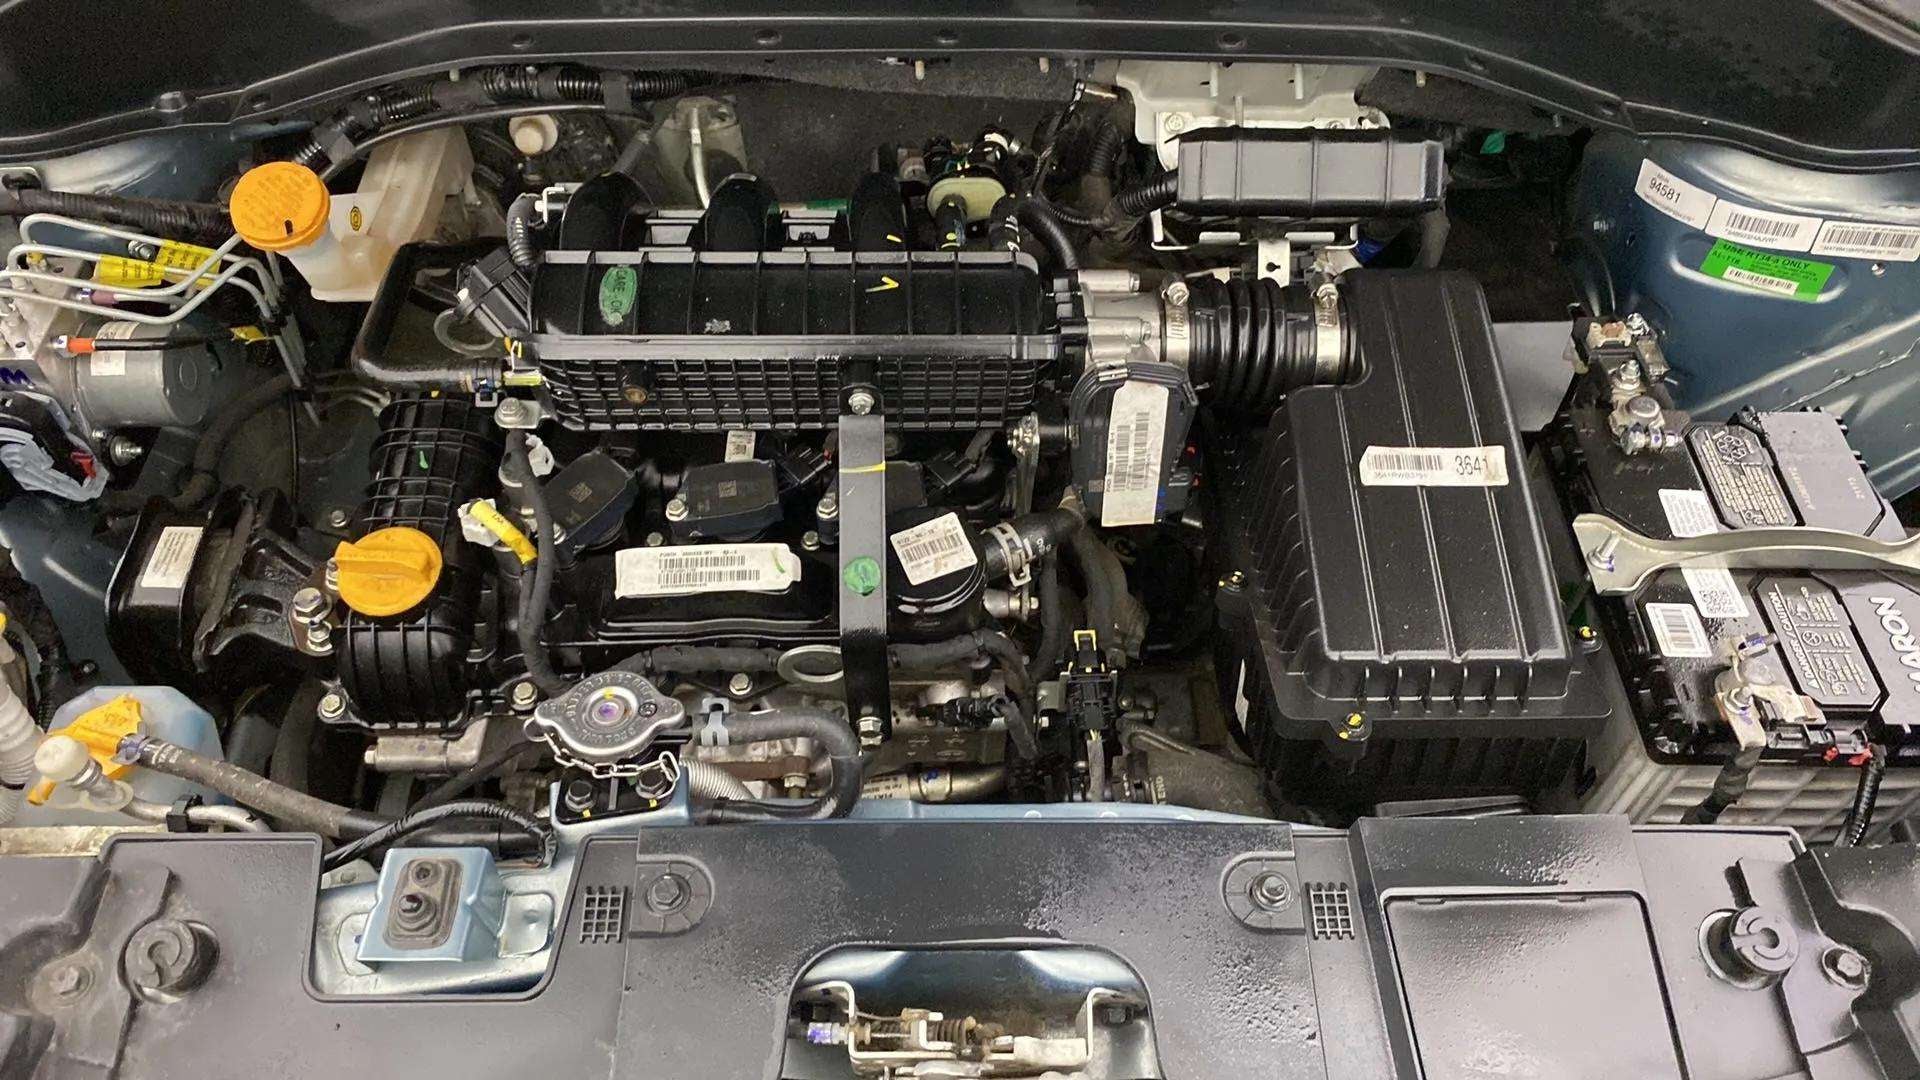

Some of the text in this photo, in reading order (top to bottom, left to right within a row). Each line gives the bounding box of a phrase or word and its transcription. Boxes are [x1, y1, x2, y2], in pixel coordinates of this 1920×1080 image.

[1649, 177, 1681, 203] 94581
[1782, 258, 1811, 270] ONLY
[1768, 591, 1793, 632] CAUTION
[1790, 640, 1815, 680] DANGER
